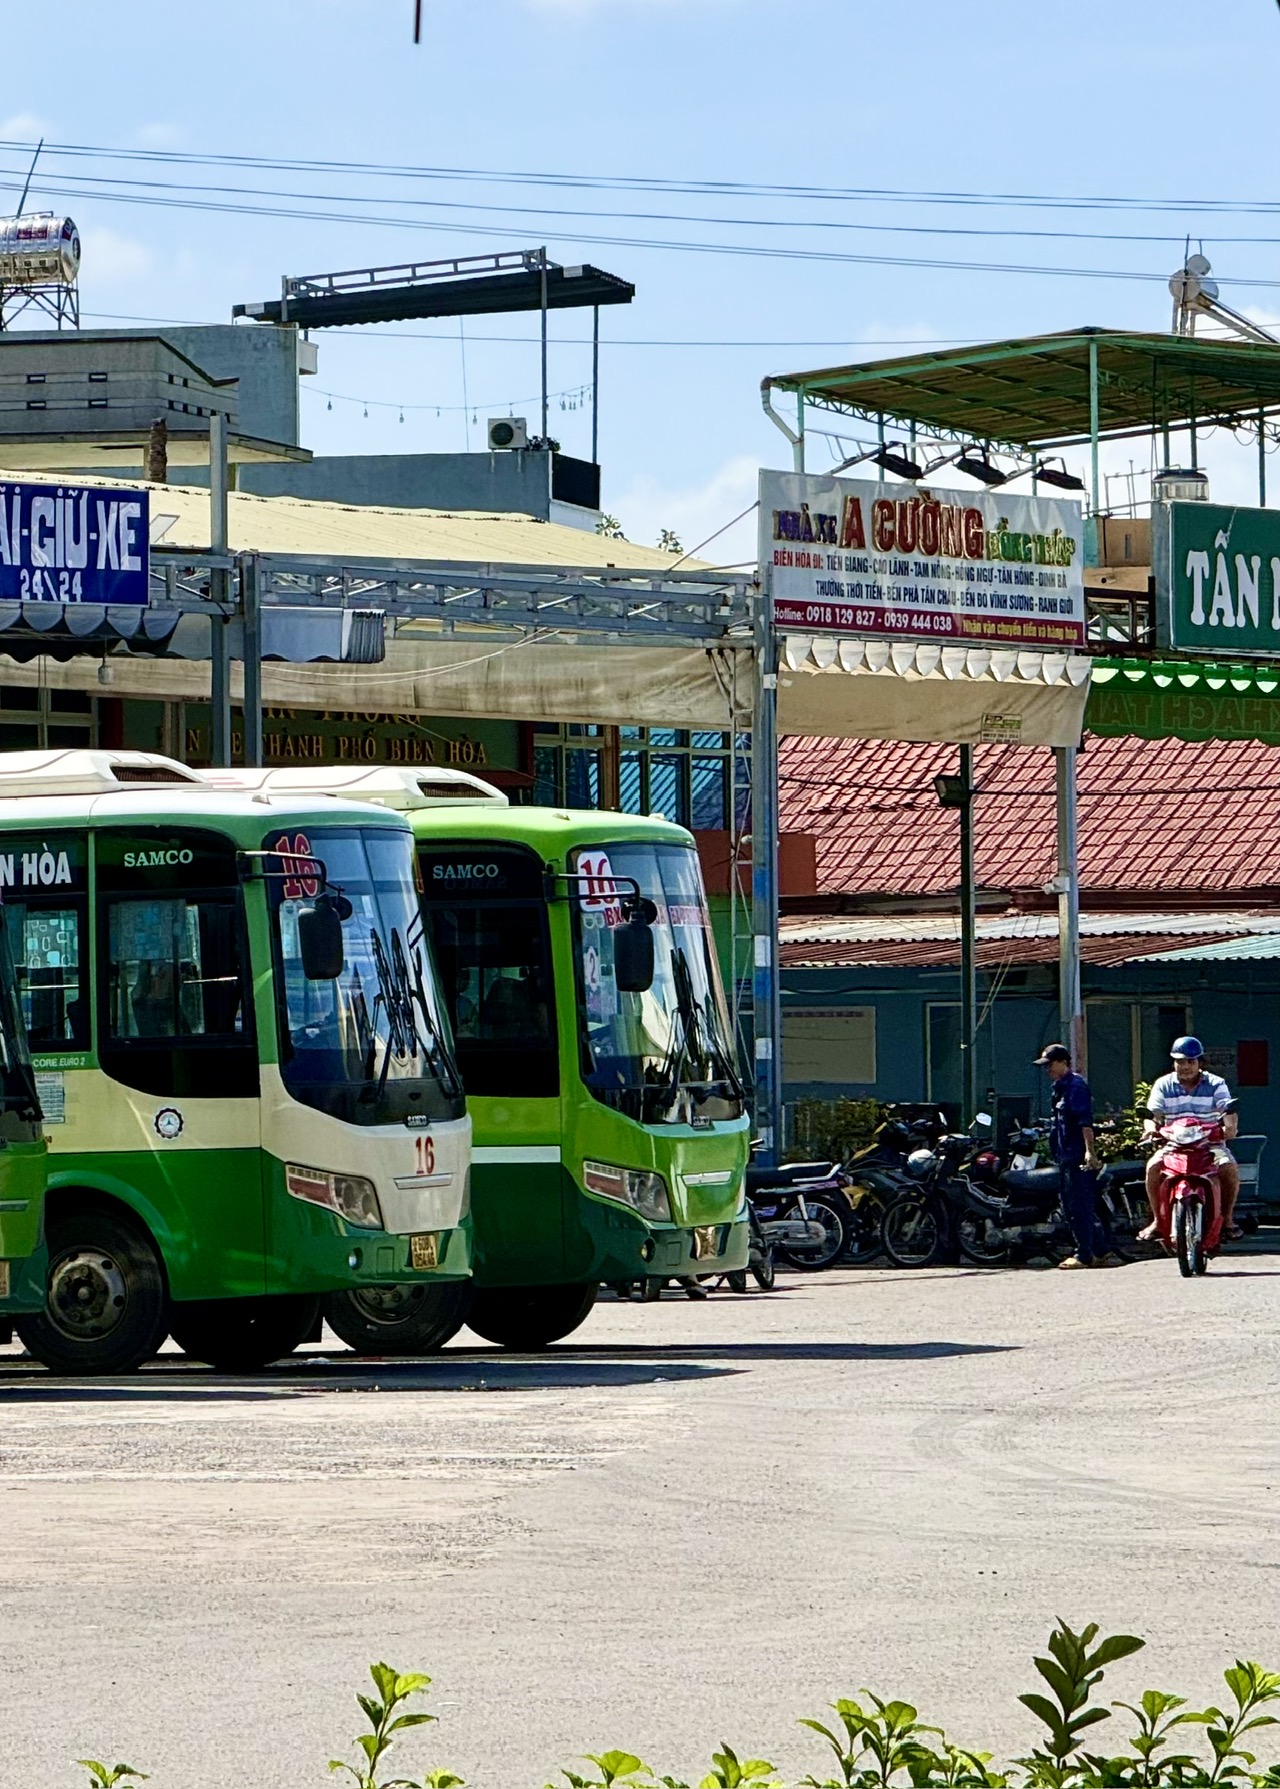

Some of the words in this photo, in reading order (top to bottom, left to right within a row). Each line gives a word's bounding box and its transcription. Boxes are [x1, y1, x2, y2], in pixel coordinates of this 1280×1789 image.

[839, 495, 866, 549] A
[871, 490, 985, 559] CƯỜNG
[773, 548, 793, 567] BIÊN
[795, 548, 811, 569] HÒA
[845, 556, 868, 574] GIANG
[873, 559, 887, 575] CAO
[914, 562, 929, 578] TAM
[806, 605, 832, 622] 0918
[835, 607, 853, 624] 129
[856, 609, 875, 626] 827
[884, 611, 908, 628] 0939
[911, 612, 931, 629] 444
[933, 615, 952, 632] 038
[339, 728, 378, 760] PHỐ
[390, 731, 435, 762] BIÊN
[450, 733, 487, 765] HÒA
[22, 842, 72, 886] HÒA
[124, 849, 193, 868] SAMCO
[275, 833, 318, 899] 16
[432, 863, 499, 879] SAMCO
[415, 1135, 435, 1175] 16
